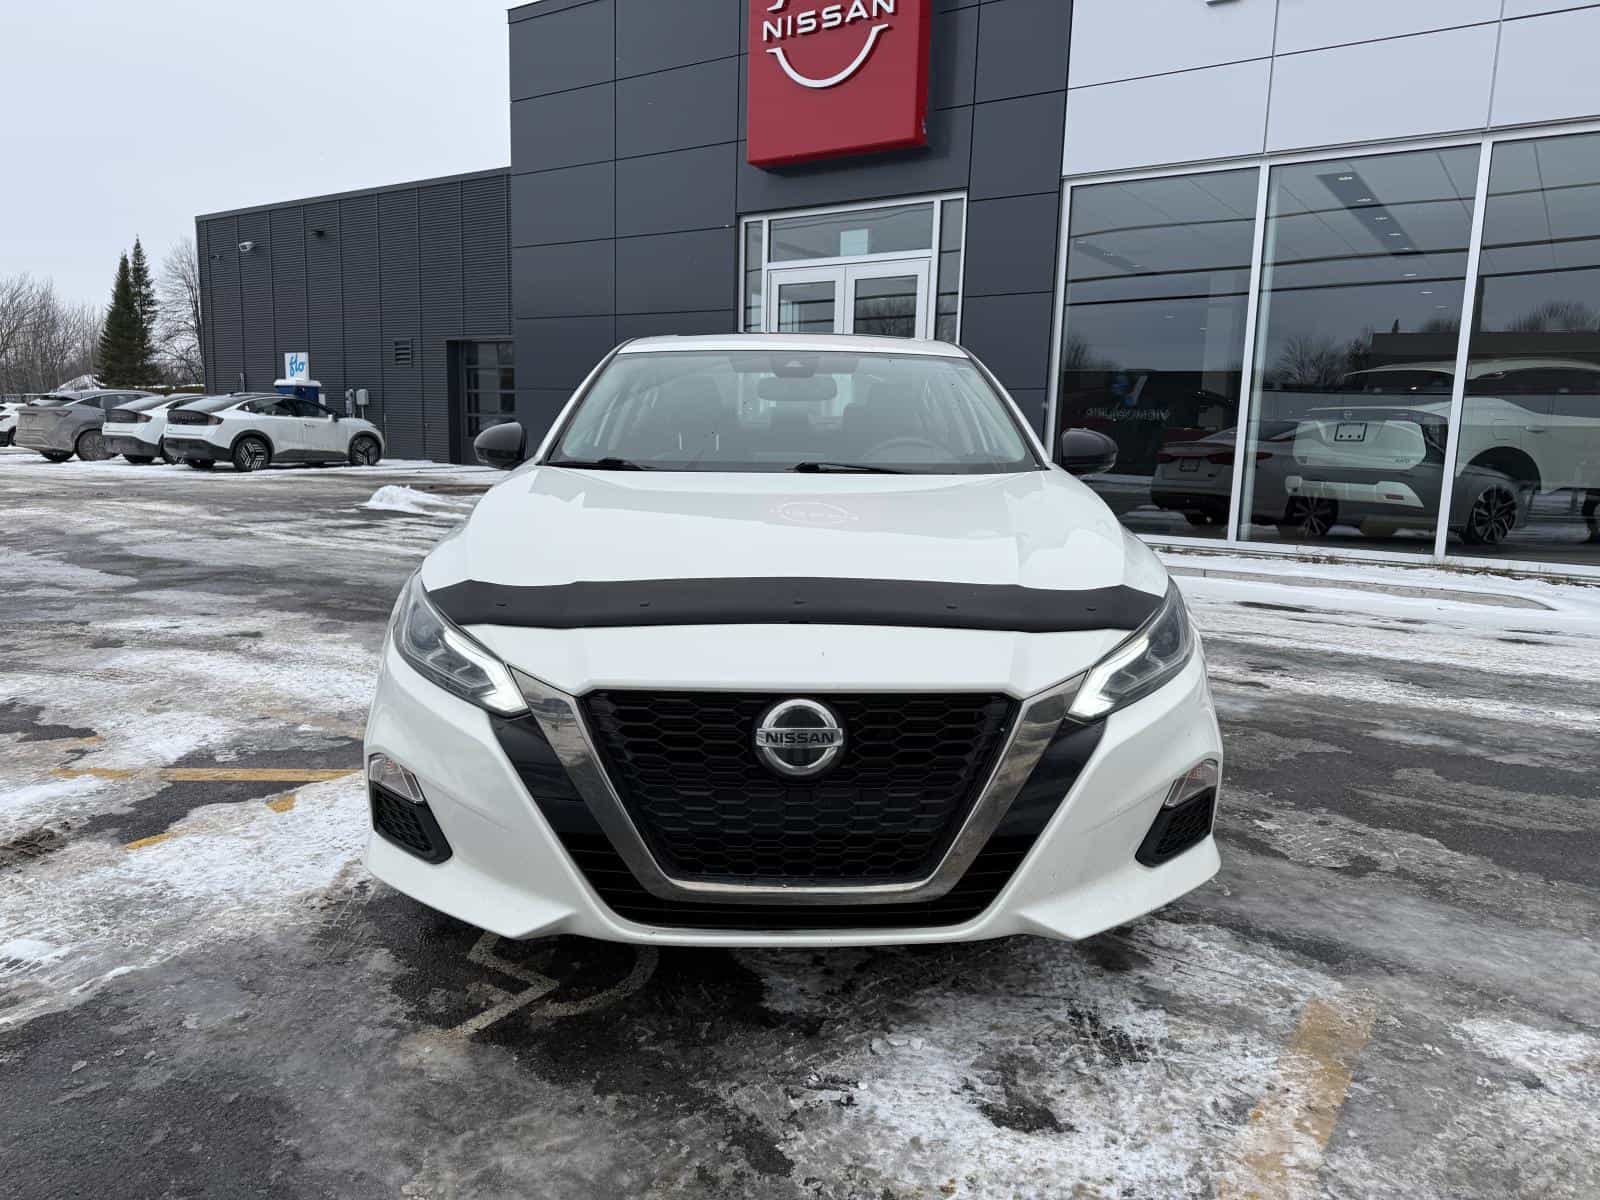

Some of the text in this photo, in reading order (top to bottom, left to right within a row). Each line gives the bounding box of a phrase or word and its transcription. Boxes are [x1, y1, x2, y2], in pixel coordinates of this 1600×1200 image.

[762, 0, 895, 41] NISSAN
[289, 353, 305, 376] flo
[765, 732, 834, 743] NISSAN
